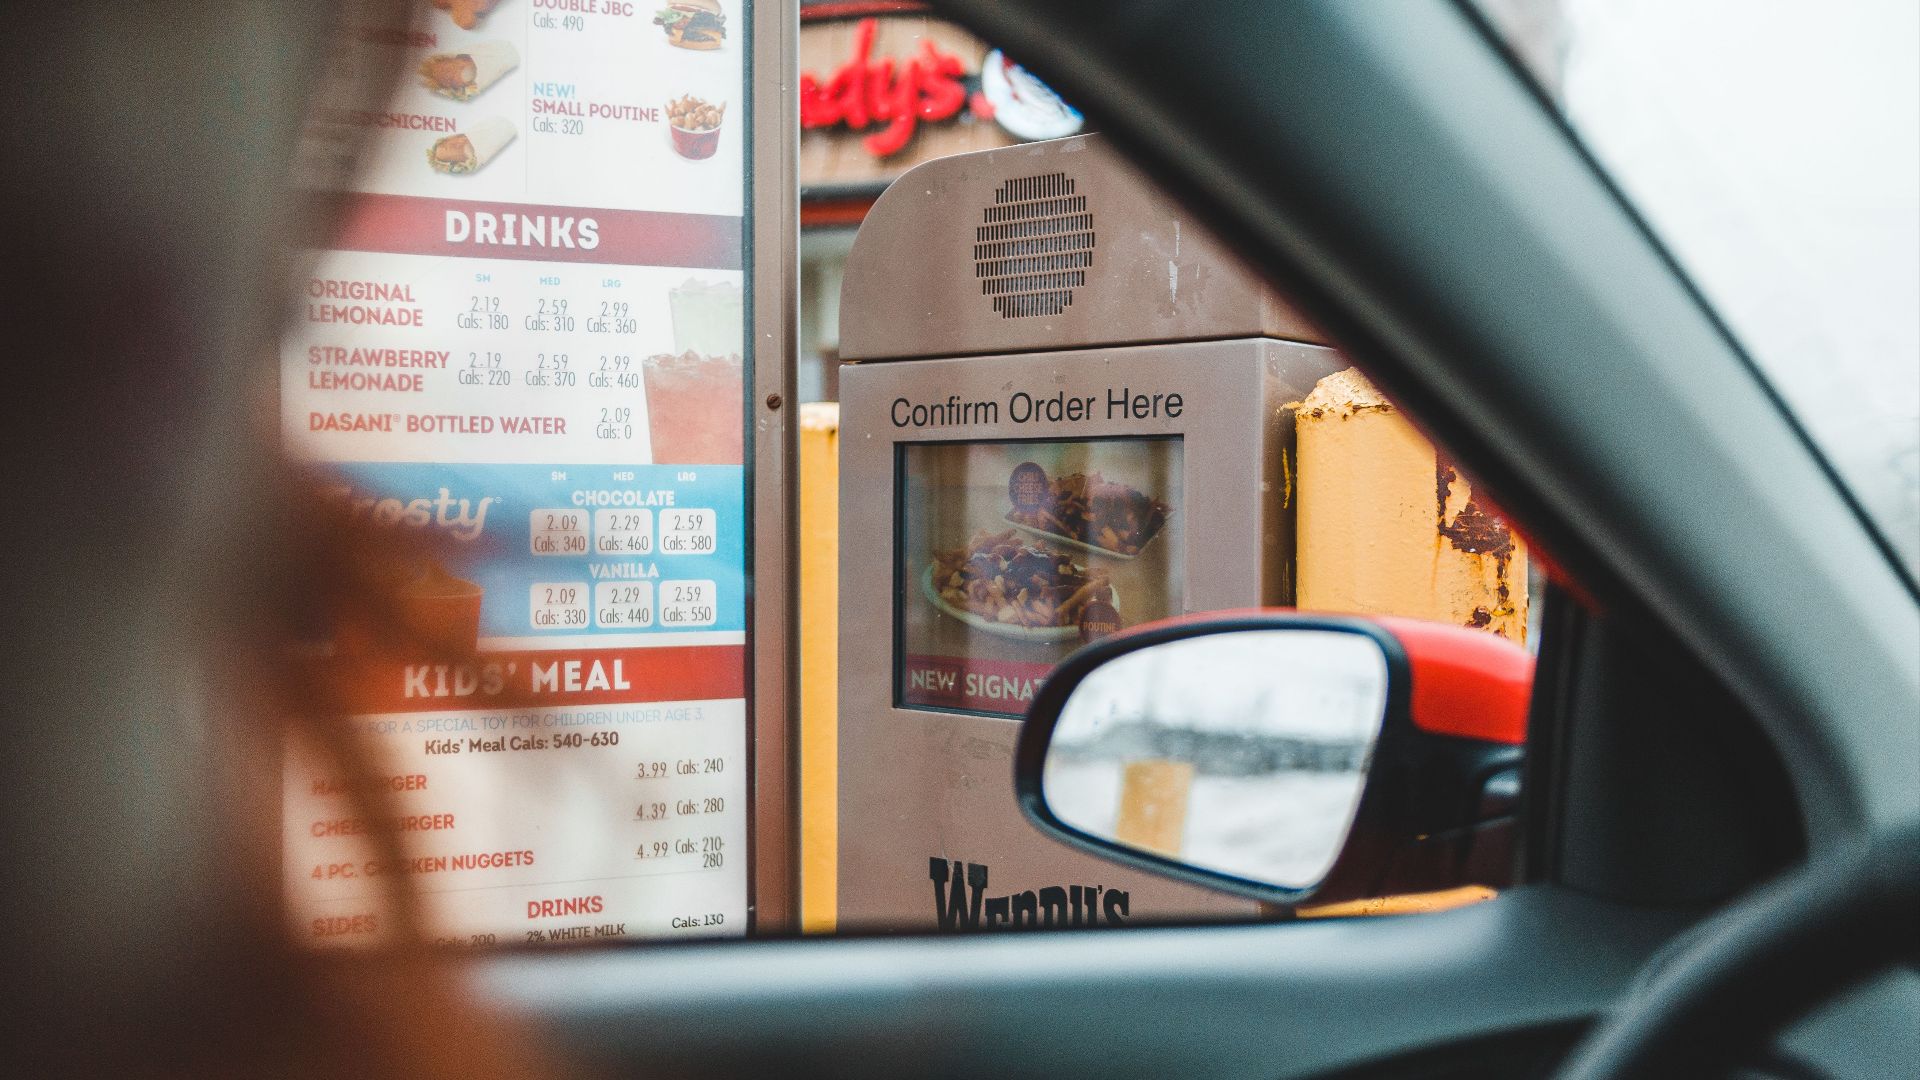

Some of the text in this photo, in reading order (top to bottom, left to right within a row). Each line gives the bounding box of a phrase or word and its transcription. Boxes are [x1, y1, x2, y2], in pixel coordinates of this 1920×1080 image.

[601, 1, 634, 17] JBC
[533, 12, 584, 31] Cals: 490
[533, 82, 575, 98] NEW!
[532, 99, 659, 122] SMALL POUTINE
[533, 117, 584, 135] Cals: 320
[446, 211, 600, 250] DRINKS
[309, 278, 416, 302] ORIGINAL
[475, 274, 622, 289] SM MED LRG
[471, 296, 500, 312] 2.19
[538, 298, 568, 314] 2.59
[601, 301, 629, 318] 2.99
[308, 304, 424, 326] LEMONADE
[457, 313, 509, 330] Cals: 180
[525, 315, 575, 332] Cals: 310
[587, 317, 637, 334] Cals: 360
[308, 346, 450, 368] STRAWBERRY
[469, 352, 502, 368] 2.19
[538, 354, 568, 370] 2.59
[600, 355, 630, 372] 2.99
[309, 370, 424, 392] LEMONADE
[458, 370, 511, 386] Cals: 220
[525, 371, 576, 387] Cals: 370
[588, 372, 639, 388] Cals: 460
[600, 407, 631, 424] 2.09
[891, 388, 1183, 428] Confirm Order Here
[406, 414, 494, 434] BOTTLED
[500, 416, 566, 435] WATER
[596, 424, 632, 440] Cals: 0
[552, 471, 696, 482] SM MED LRG
[572, 490, 675, 506] CHOCOLATE
[546, 514, 578, 530] 2.09
[610, 514, 640, 531] 2.29
[674, 514, 703, 531] 2.59
[534, 536, 586, 551] Cals: 340
[598, 536, 648, 551] Cals: 460
[663, 535, 712, 550] Cals: 580
[588, 562, 660, 579] VANILLA
[546, 588, 576, 604] 2.09
[611, 587, 640, 604] 2.29
[675, 586, 702, 602] 2.59
[535, 609, 586, 625] Cals: 330
[599, 608, 649, 624] Cals: 440
[663, 606, 712, 622] Cals: 550
[531, 658, 631, 694] MEAL
[911, 669, 956, 691] NEW
[401, 721, 412, 734] A
[416, 717, 478, 733] SPECIAL
[480, 716, 508, 730] TOY
[512, 715, 540, 728] FOR
[544, 712, 612, 727] CHILDREN
[616, 710, 660, 724] UNDER
[664, 708, 690, 722] AGE
[425, 731, 620, 755] Kids' Meal Cals: 540-630
[638, 762, 668, 778] 3.99
[676, 758, 724, 775] Cals: 240
[636, 802, 667, 820] 4.39
[676, 798, 724, 816] Cals: 280
[637, 842, 668, 859] 4.99
[676, 838, 698, 854] Cals:
[312, 864, 322, 880] 4
[328, 862, 358, 880] PC.
[452, 850, 534, 872] NUGGETS
[703, 852, 723, 868] 280
[527, 895, 604, 919] DRINKS
[312, 914, 377, 937] SIDES
[672, 913, 724, 930] Cals: 130
[526, 922, 626, 943] 2% WHITE MILK
